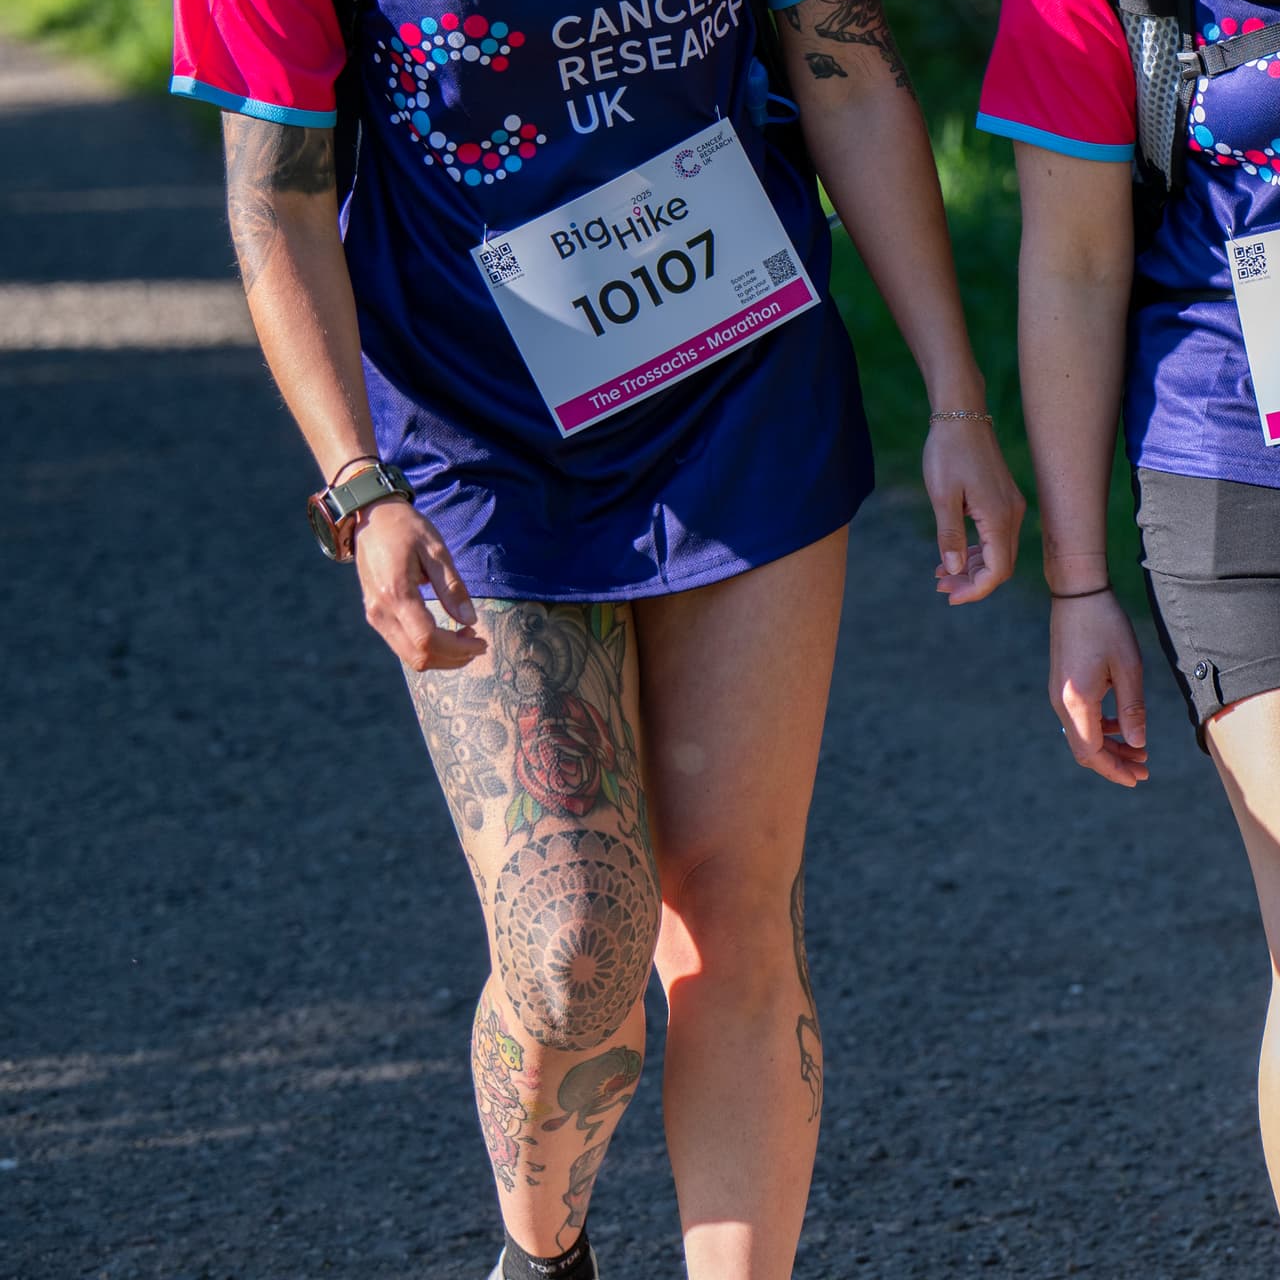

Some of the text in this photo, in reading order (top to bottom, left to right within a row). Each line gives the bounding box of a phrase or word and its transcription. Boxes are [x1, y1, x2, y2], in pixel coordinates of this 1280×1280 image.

[566, 86, 635, 135] UK
[631, 189, 653, 206] 2025
[572, 229, 715, 337] 10107
[588, 387, 621, 410] The
[620, 342, 699, 393] Trossachs
[706, 300, 781, 350] Marathon
